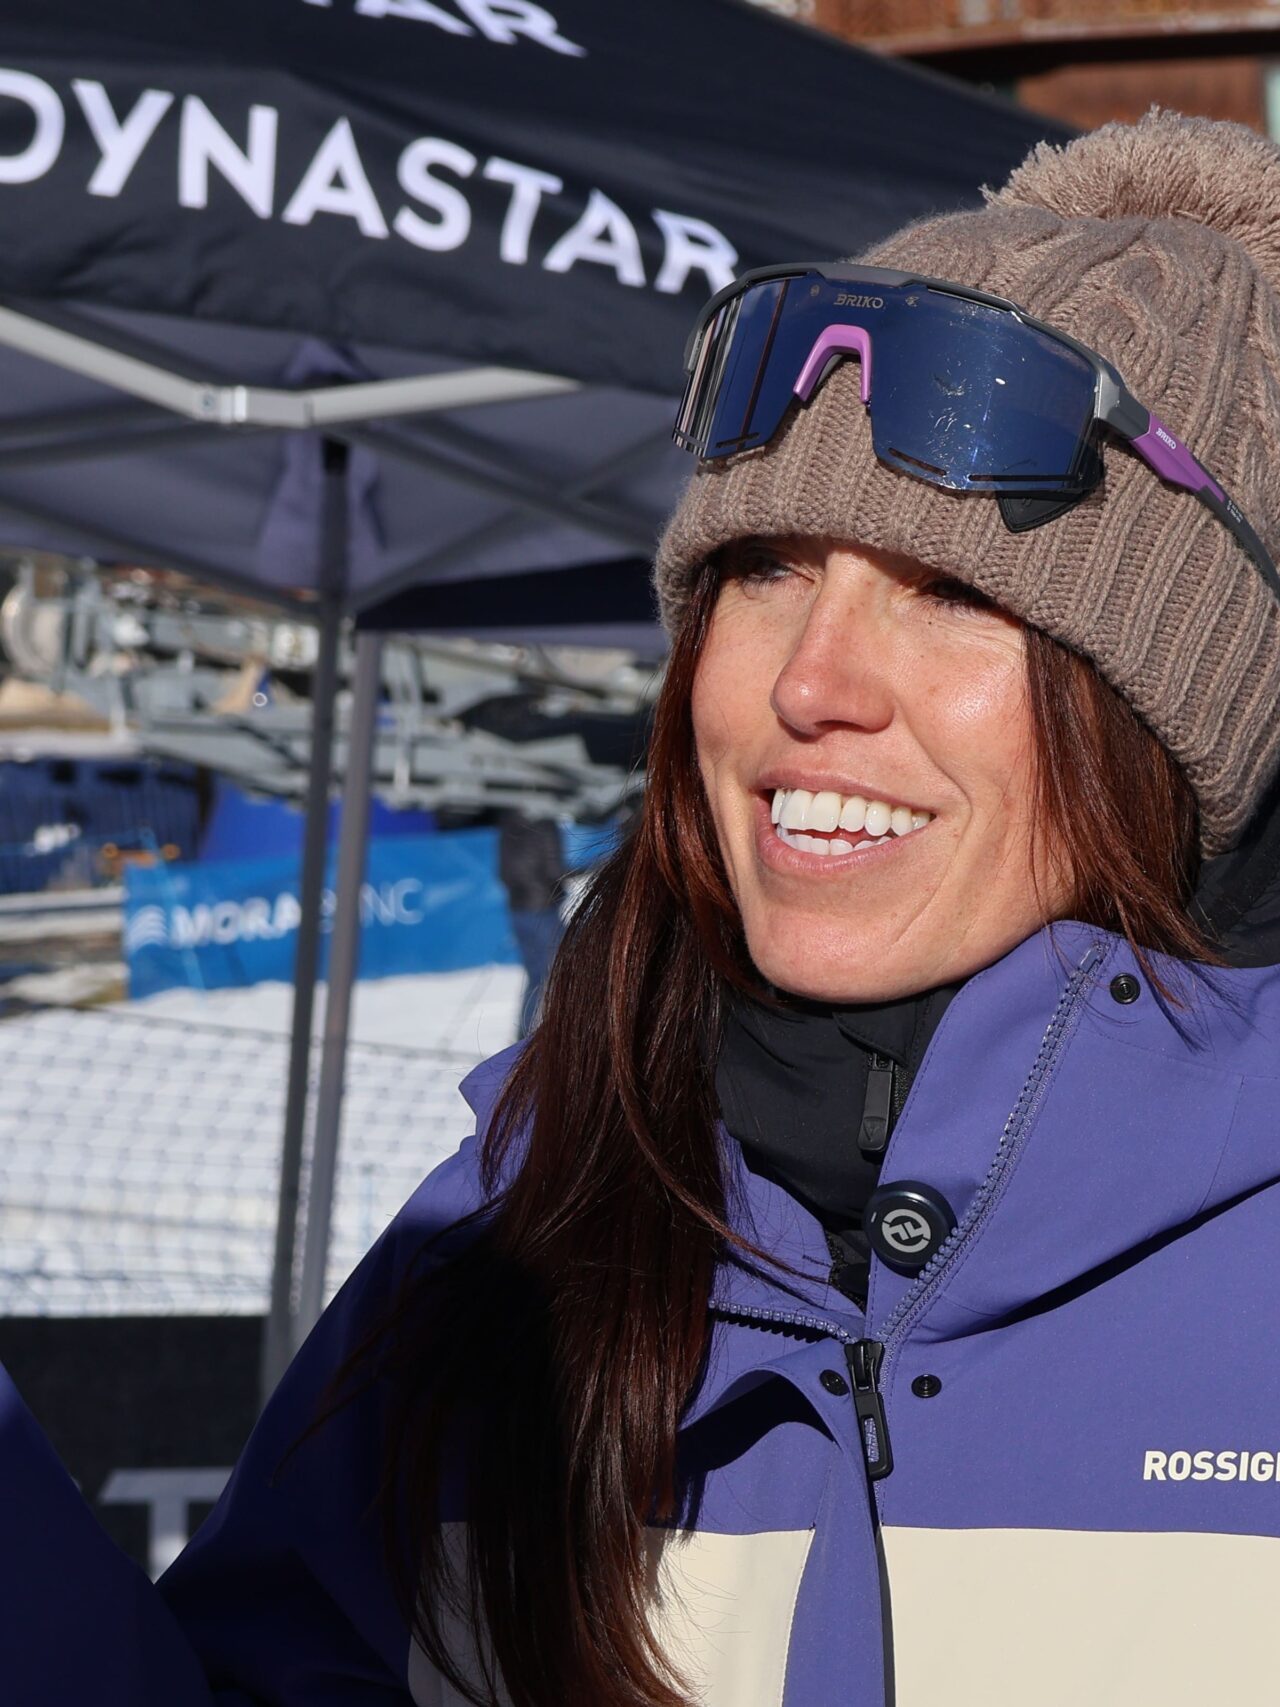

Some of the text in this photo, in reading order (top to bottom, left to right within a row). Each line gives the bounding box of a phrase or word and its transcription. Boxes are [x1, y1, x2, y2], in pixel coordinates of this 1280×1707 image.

[0, 68, 740, 300] DYNASTAR
[833, 293, 884, 310] BRIKO
[1155, 427, 1176, 450] BRIKO
